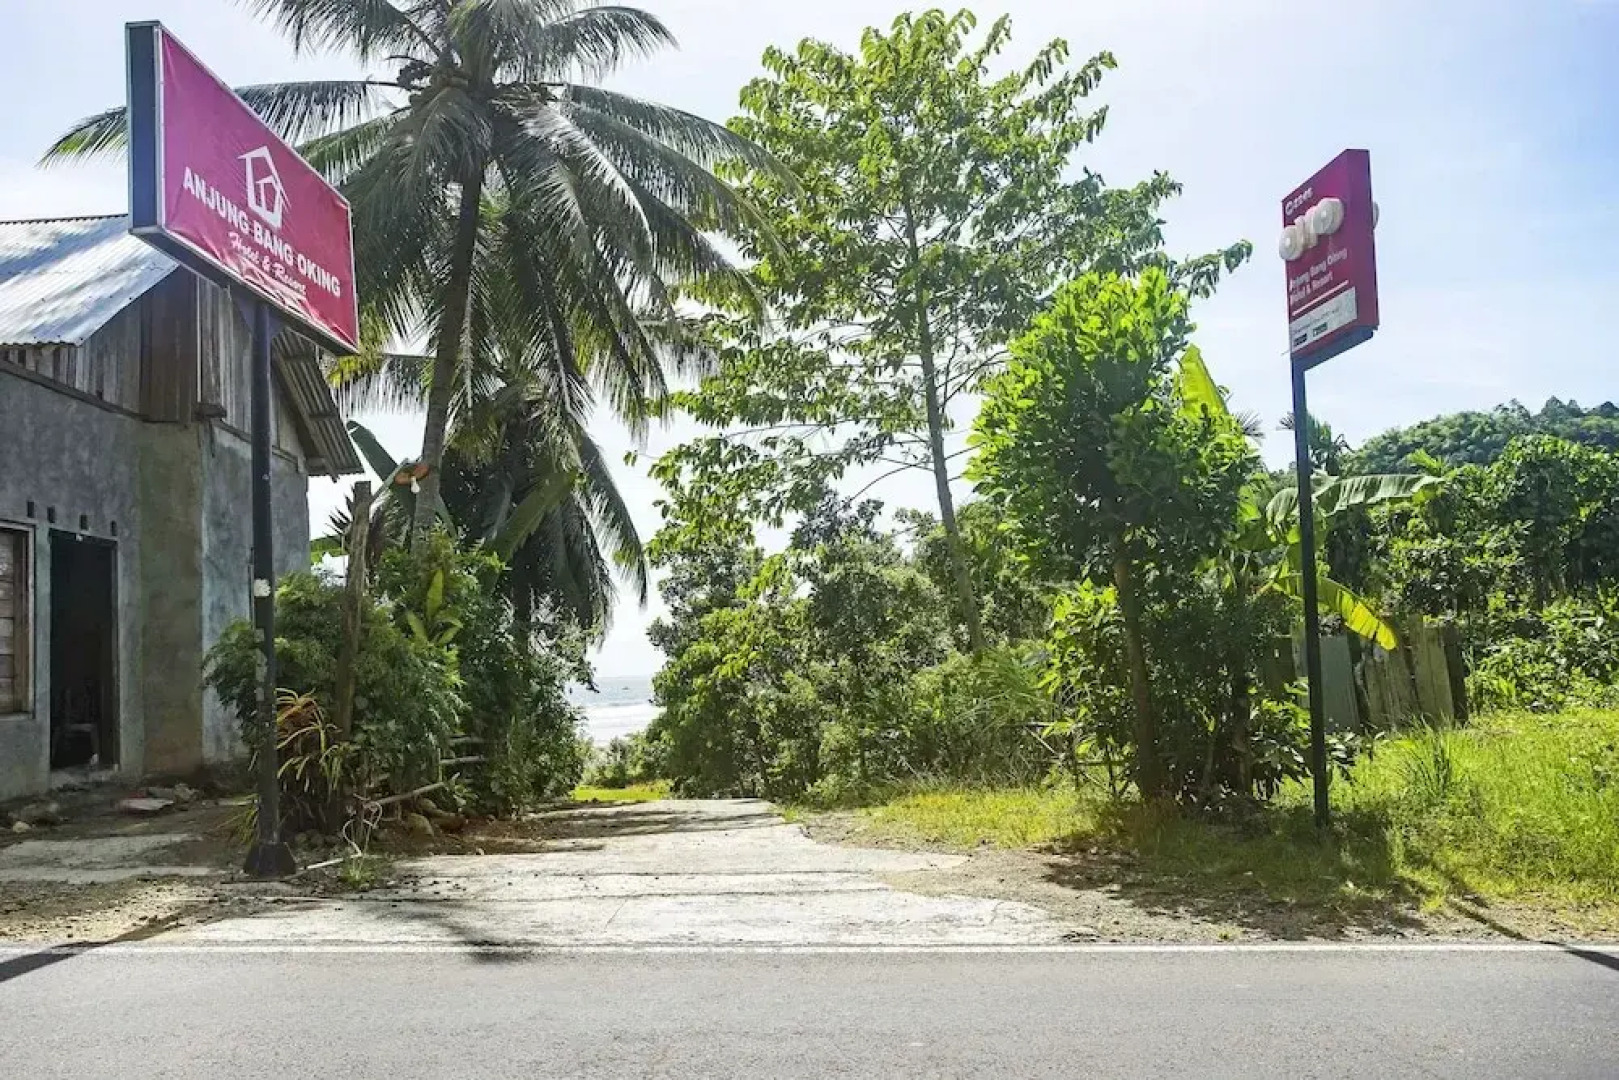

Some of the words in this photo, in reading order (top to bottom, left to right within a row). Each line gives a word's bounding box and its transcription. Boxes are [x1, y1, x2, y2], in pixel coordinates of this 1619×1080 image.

[183, 166, 250, 236] ANJUNG
[253, 219, 294, 266] BANG
[297, 253, 341, 297] OKING
[262, 255, 271, 273] &
